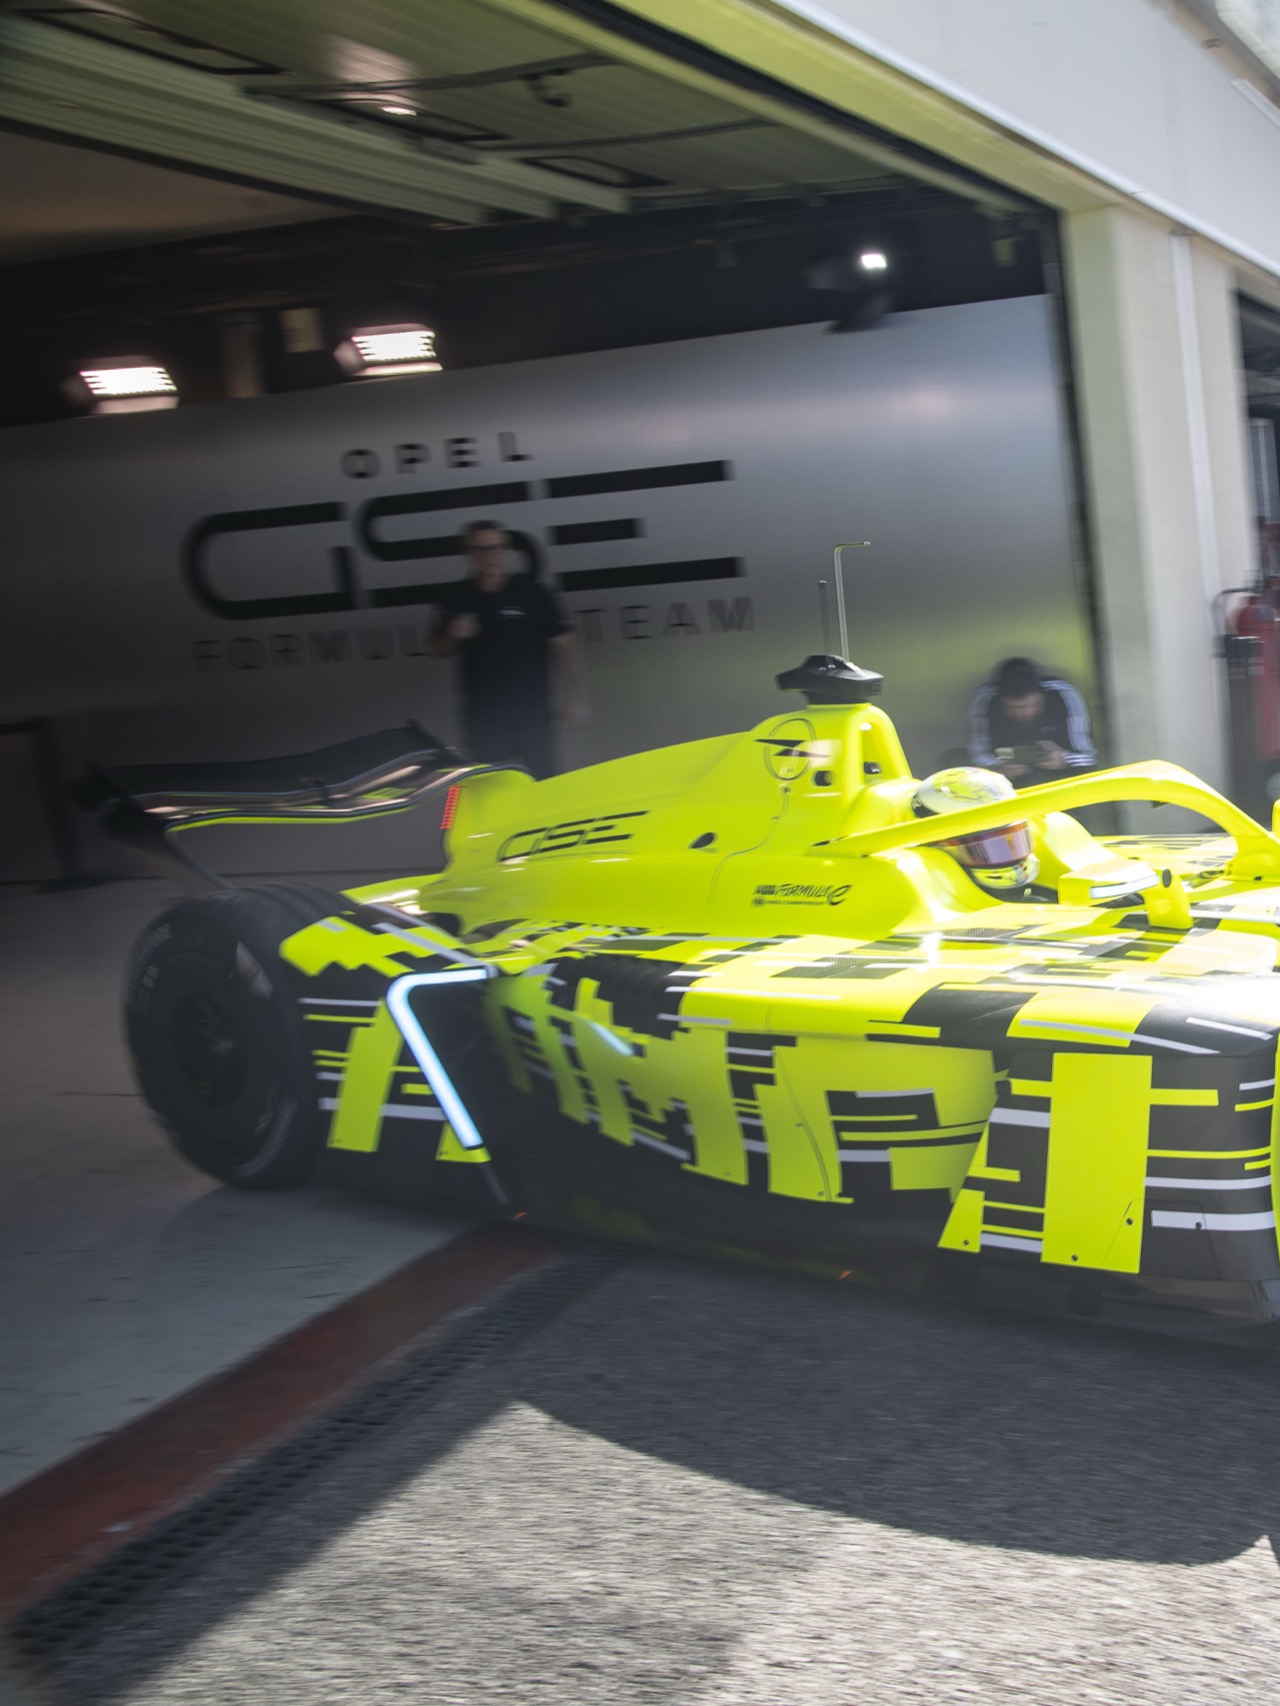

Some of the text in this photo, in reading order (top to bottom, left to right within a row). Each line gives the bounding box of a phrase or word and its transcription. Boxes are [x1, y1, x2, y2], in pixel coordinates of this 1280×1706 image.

[340, 432, 533, 480] OPEL
[181, 459, 747, 621] GSE
[191, 596, 756, 672] FORMUL TEAM
[496, 810, 651, 862] GSE
